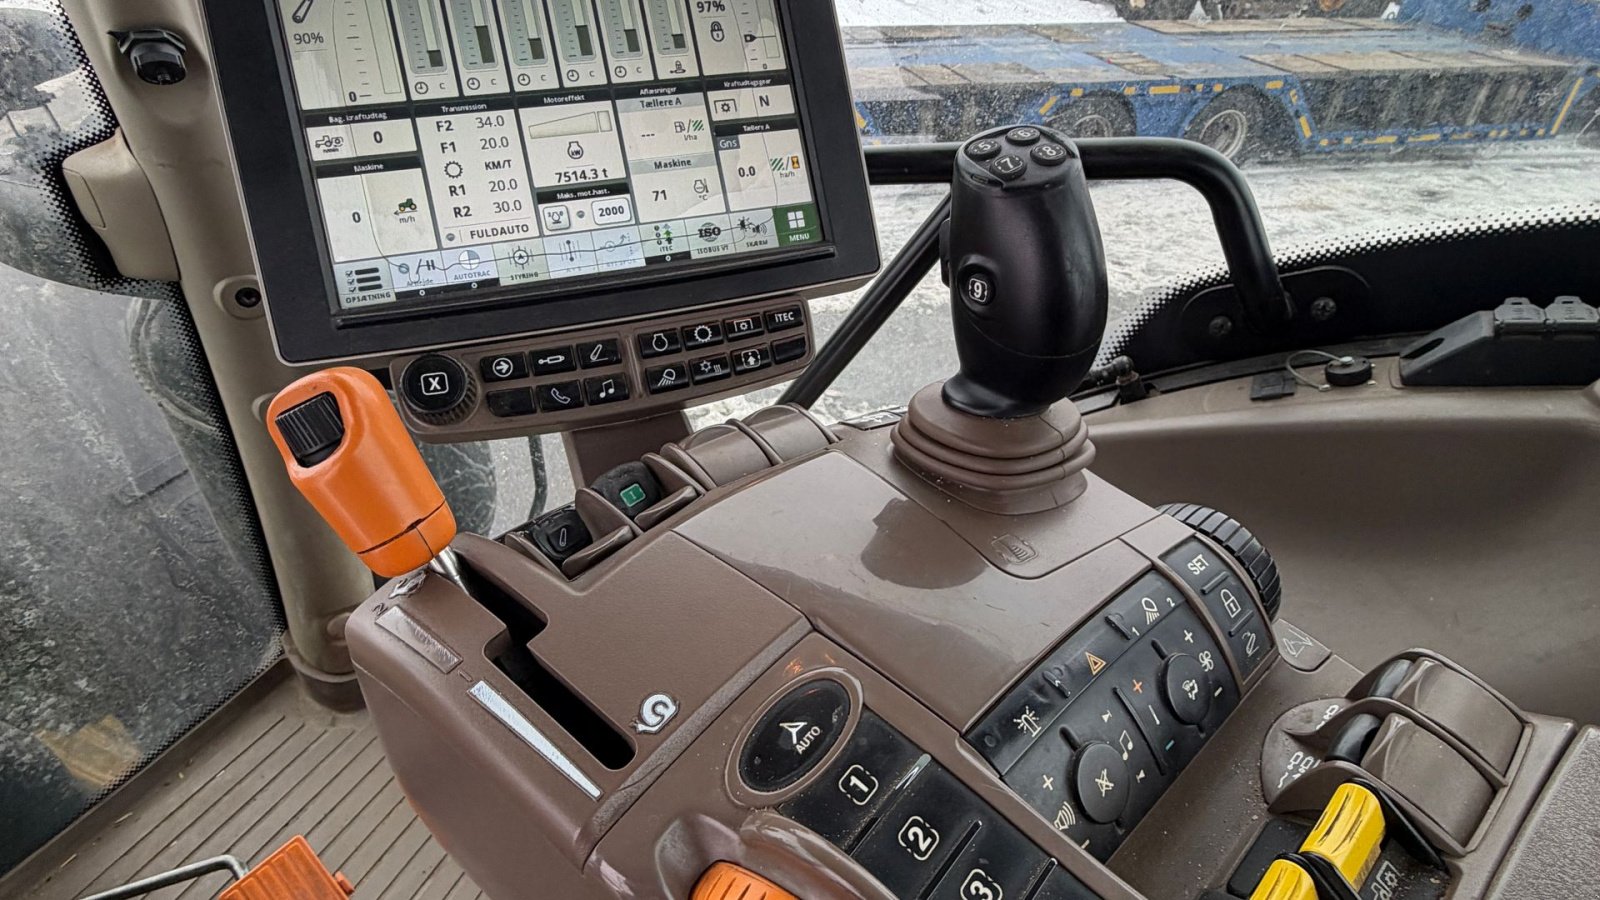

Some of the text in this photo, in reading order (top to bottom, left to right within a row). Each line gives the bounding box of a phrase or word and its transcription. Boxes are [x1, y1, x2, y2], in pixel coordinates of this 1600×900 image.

[696, 0, 726, 13] 97%
[293, 32, 325, 45] 90%
[348, 91, 358, 103] 0
[543, 94, 585, 104] Motoreffekt
[639, 97, 682, 109] Tællere A
[759, 95, 770, 107] N
[441, 103, 488, 113] Transmission
[435, 114, 505, 133] F2 34.0
[373, 130, 384, 144] 0
[1017, 129, 1031, 138] 6
[440, 136, 509, 154] F1 20.0
[719, 139, 738, 149] Gns
[978, 142, 992, 151] 5
[1042, 146, 1057, 156] 8
[353, 163, 384, 173] Maskine
[484, 159, 512, 171] KM/T
[653, 158, 692, 169] Maskine
[1001, 157, 1014, 169] 7
[554, 168, 609, 184] 7514.3 t
[738, 165, 756, 178] 0.0
[448, 178, 518, 197] R1 20.0
[652, 189, 668, 202] 71
[453, 199, 522, 218] R2 30.0
[598, 205, 625, 217] 2000
[351, 211, 362, 224] 0
[469, 224, 530, 239] FULDAUTO
[698, 226, 721, 238] ISO
[788, 232, 810, 242] MENU
[453, 270, 491, 281] AUTOTRAC
[973, 281, 983, 299] 9
[1187, 553, 1209, 576] SET
[1166, 597, 1176, 608] 2
[1131, 626, 1140, 637] 1
[795, 725, 821, 755] AUTO
[849, 775, 870, 794] 1
[907, 826, 932, 852] 2
[969, 880, 994, 900] 3
